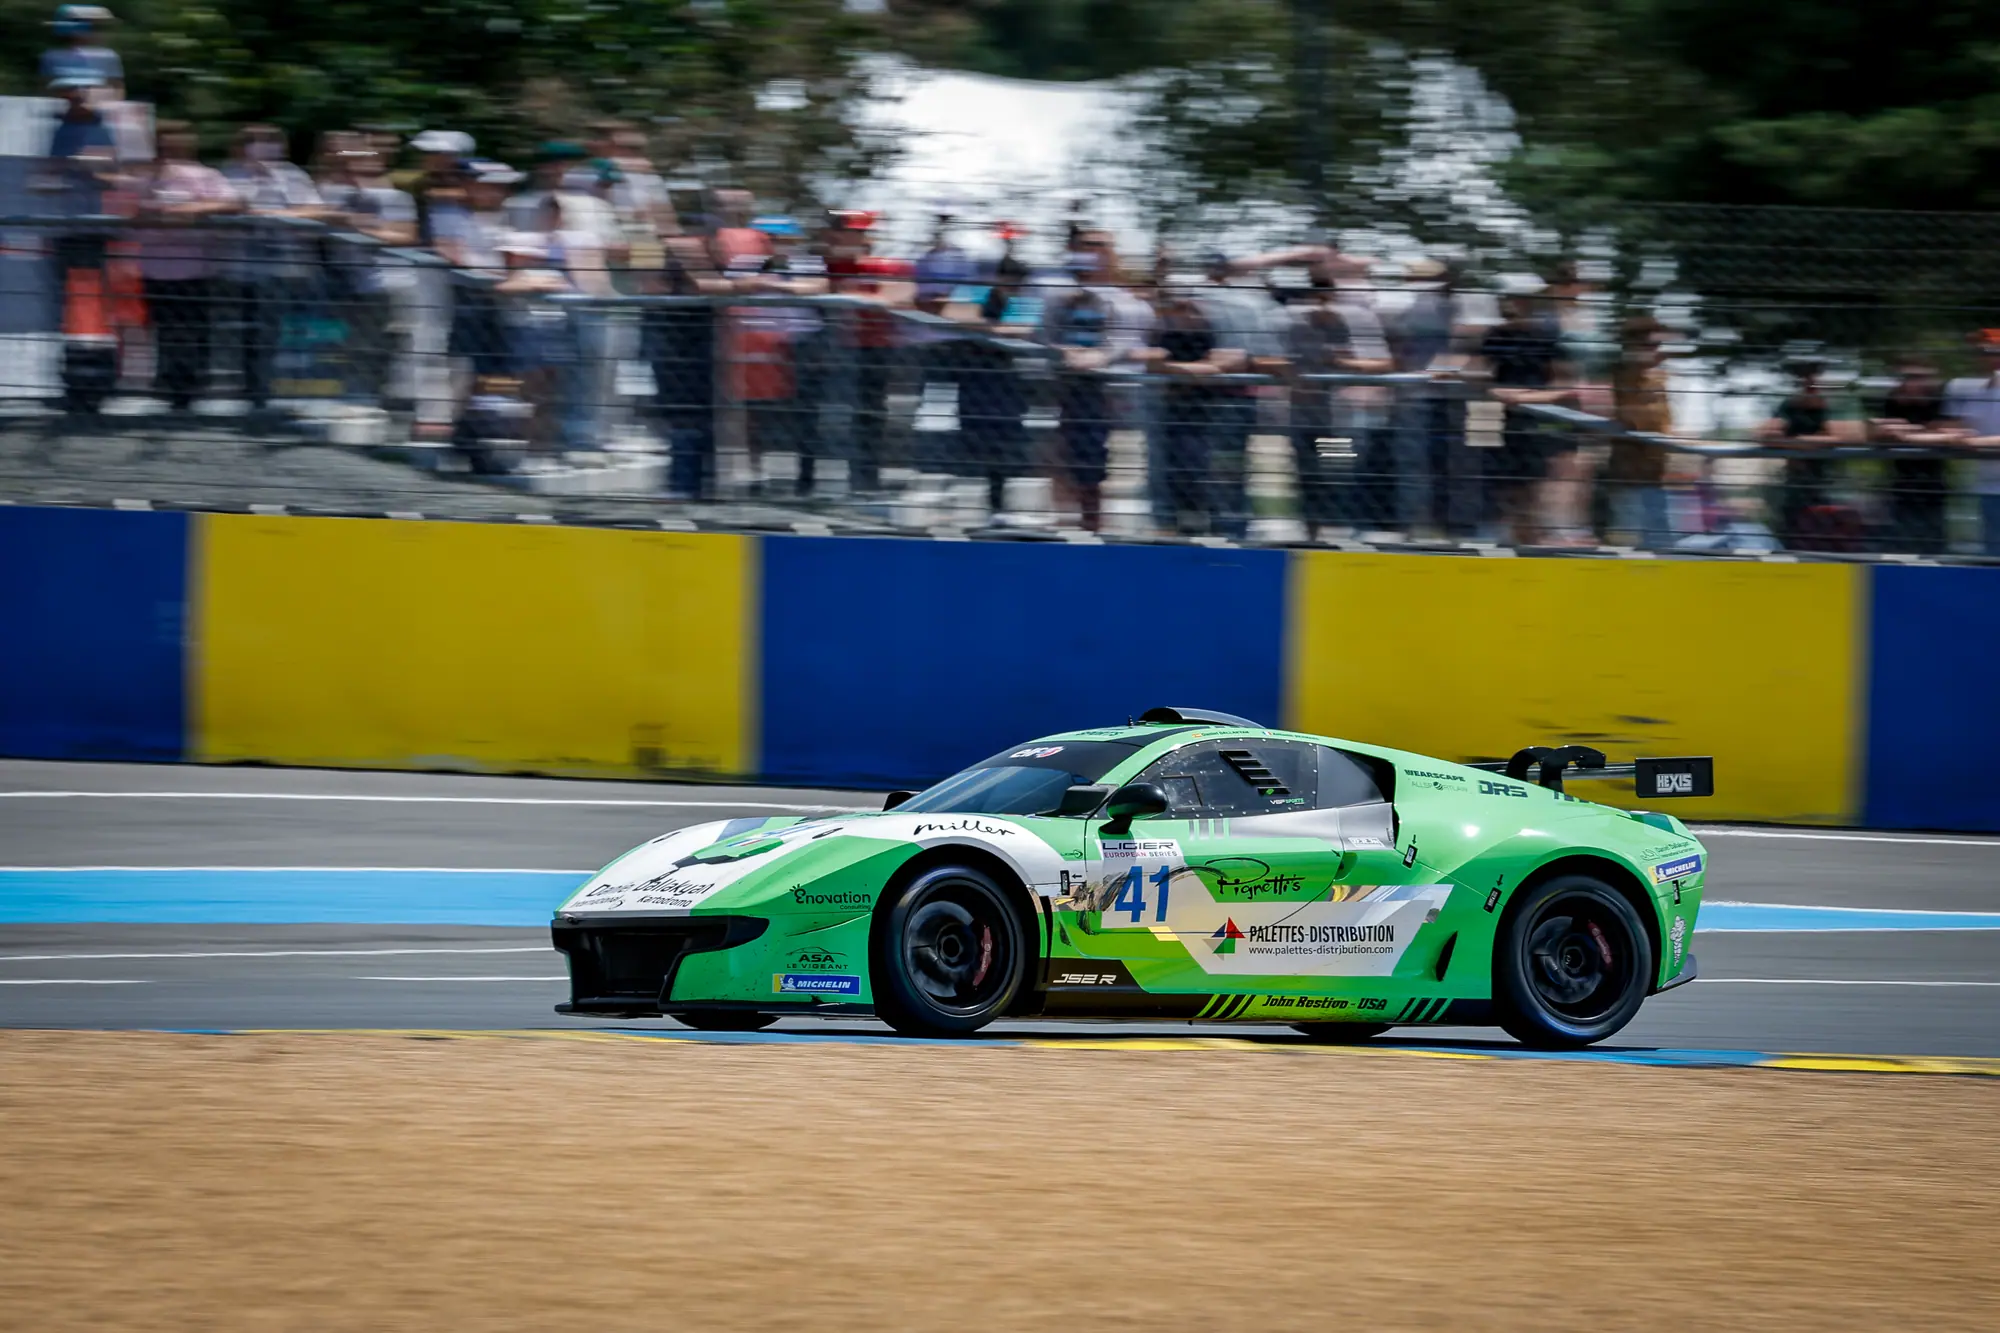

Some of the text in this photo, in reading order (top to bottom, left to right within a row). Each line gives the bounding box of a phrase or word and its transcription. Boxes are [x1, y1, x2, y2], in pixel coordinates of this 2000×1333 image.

[1404, 769, 1466, 782] WEARSCAPE
[1478, 780, 1528, 798] DRS
[1656, 773, 1693, 793] HEXIS
[913, 820, 1015, 836] miller
[1102, 842, 1174, 850] LIGIER
[1103, 851, 1146, 859] EUROPEAN
[1665, 861, 1697, 875] MICHELIN
[1114, 865, 1170, 923] 41
[637, 895, 693, 908] Kartodromo
[1249, 925, 1395, 943] PALETTES-DISTRIBUTION
[1249, 945, 1394, 956] www.palettes-distribution.com
[798, 954, 835, 963] ASA
[796, 980, 851, 989] MICHELIN
[1099, 974, 1117, 985] R
[1262, 995, 1296, 1007] John
[1296, 995, 1349, 1009] Restivo
[1357, 998, 1388, 1010] USA
